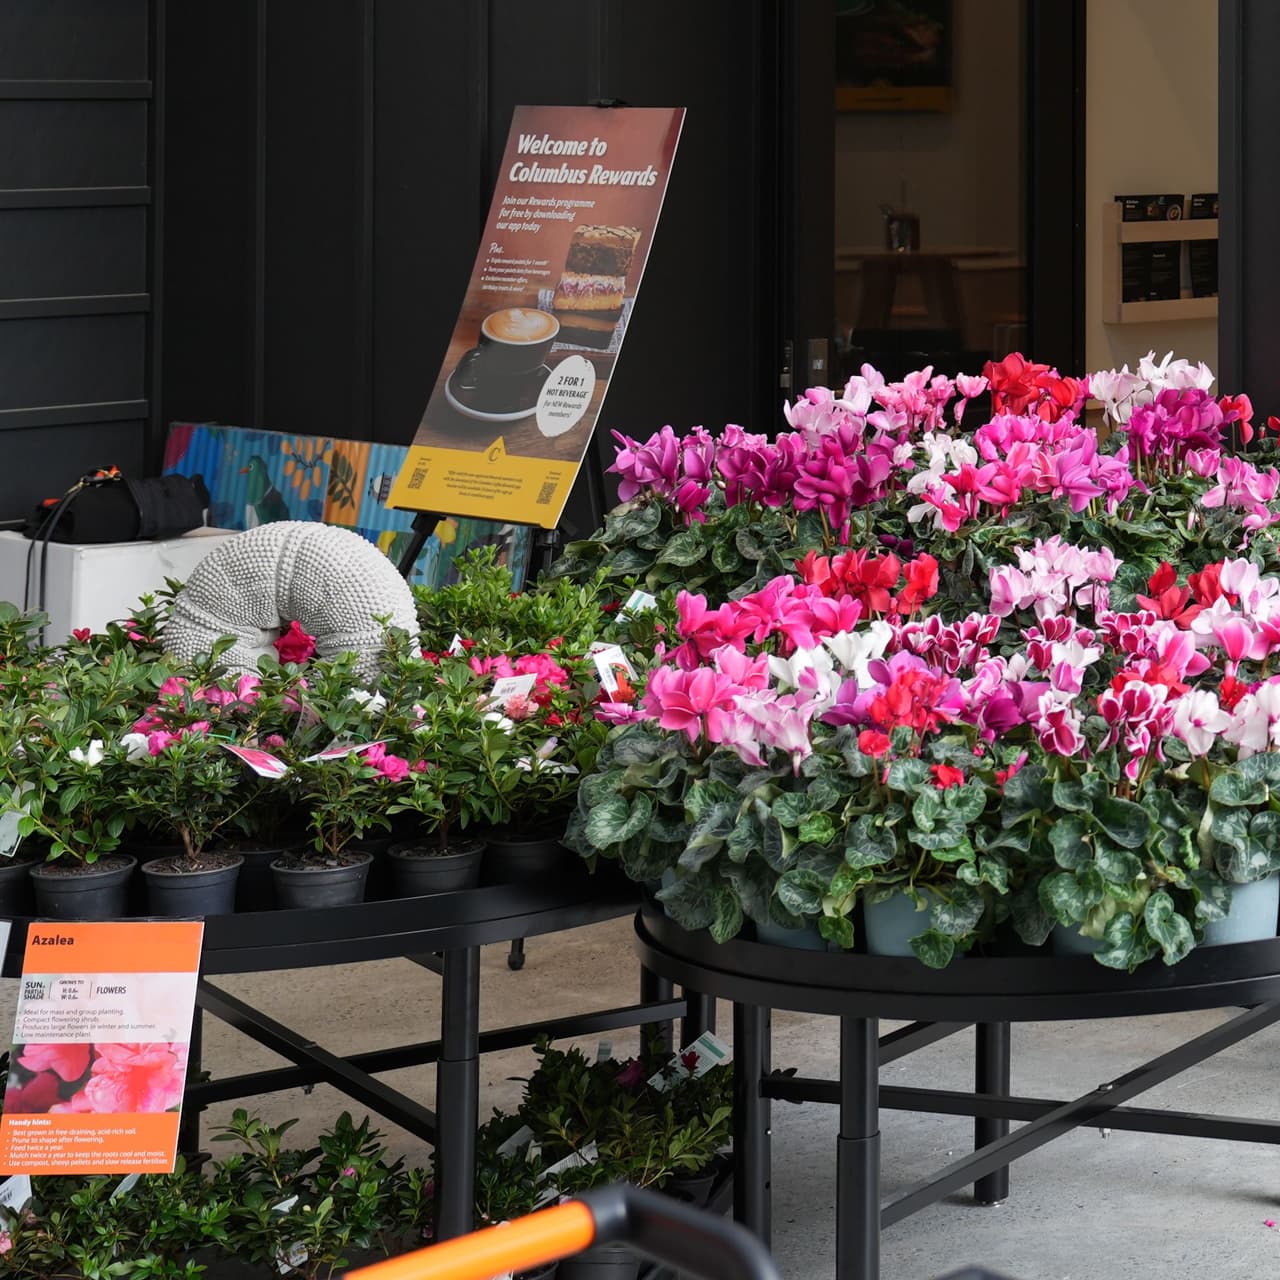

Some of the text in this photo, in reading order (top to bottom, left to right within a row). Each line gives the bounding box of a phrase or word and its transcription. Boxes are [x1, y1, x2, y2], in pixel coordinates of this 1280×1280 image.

[517, 134, 607, 156] Welcome to
[509, 161, 658, 186] Columbus Rewards
[502, 195, 595, 209] Join our Rewards programme
[498, 208, 576, 222] for free by downloading
[508, 223, 521, 232] app
[521, 222, 541, 233] today
[557, 376, 584, 387] 2 FOR 1
[32, 934, 75, 946] Azalea
[96, 986, 127, 995] FLOWERS
[51, 1016, 80, 1024] flowering
